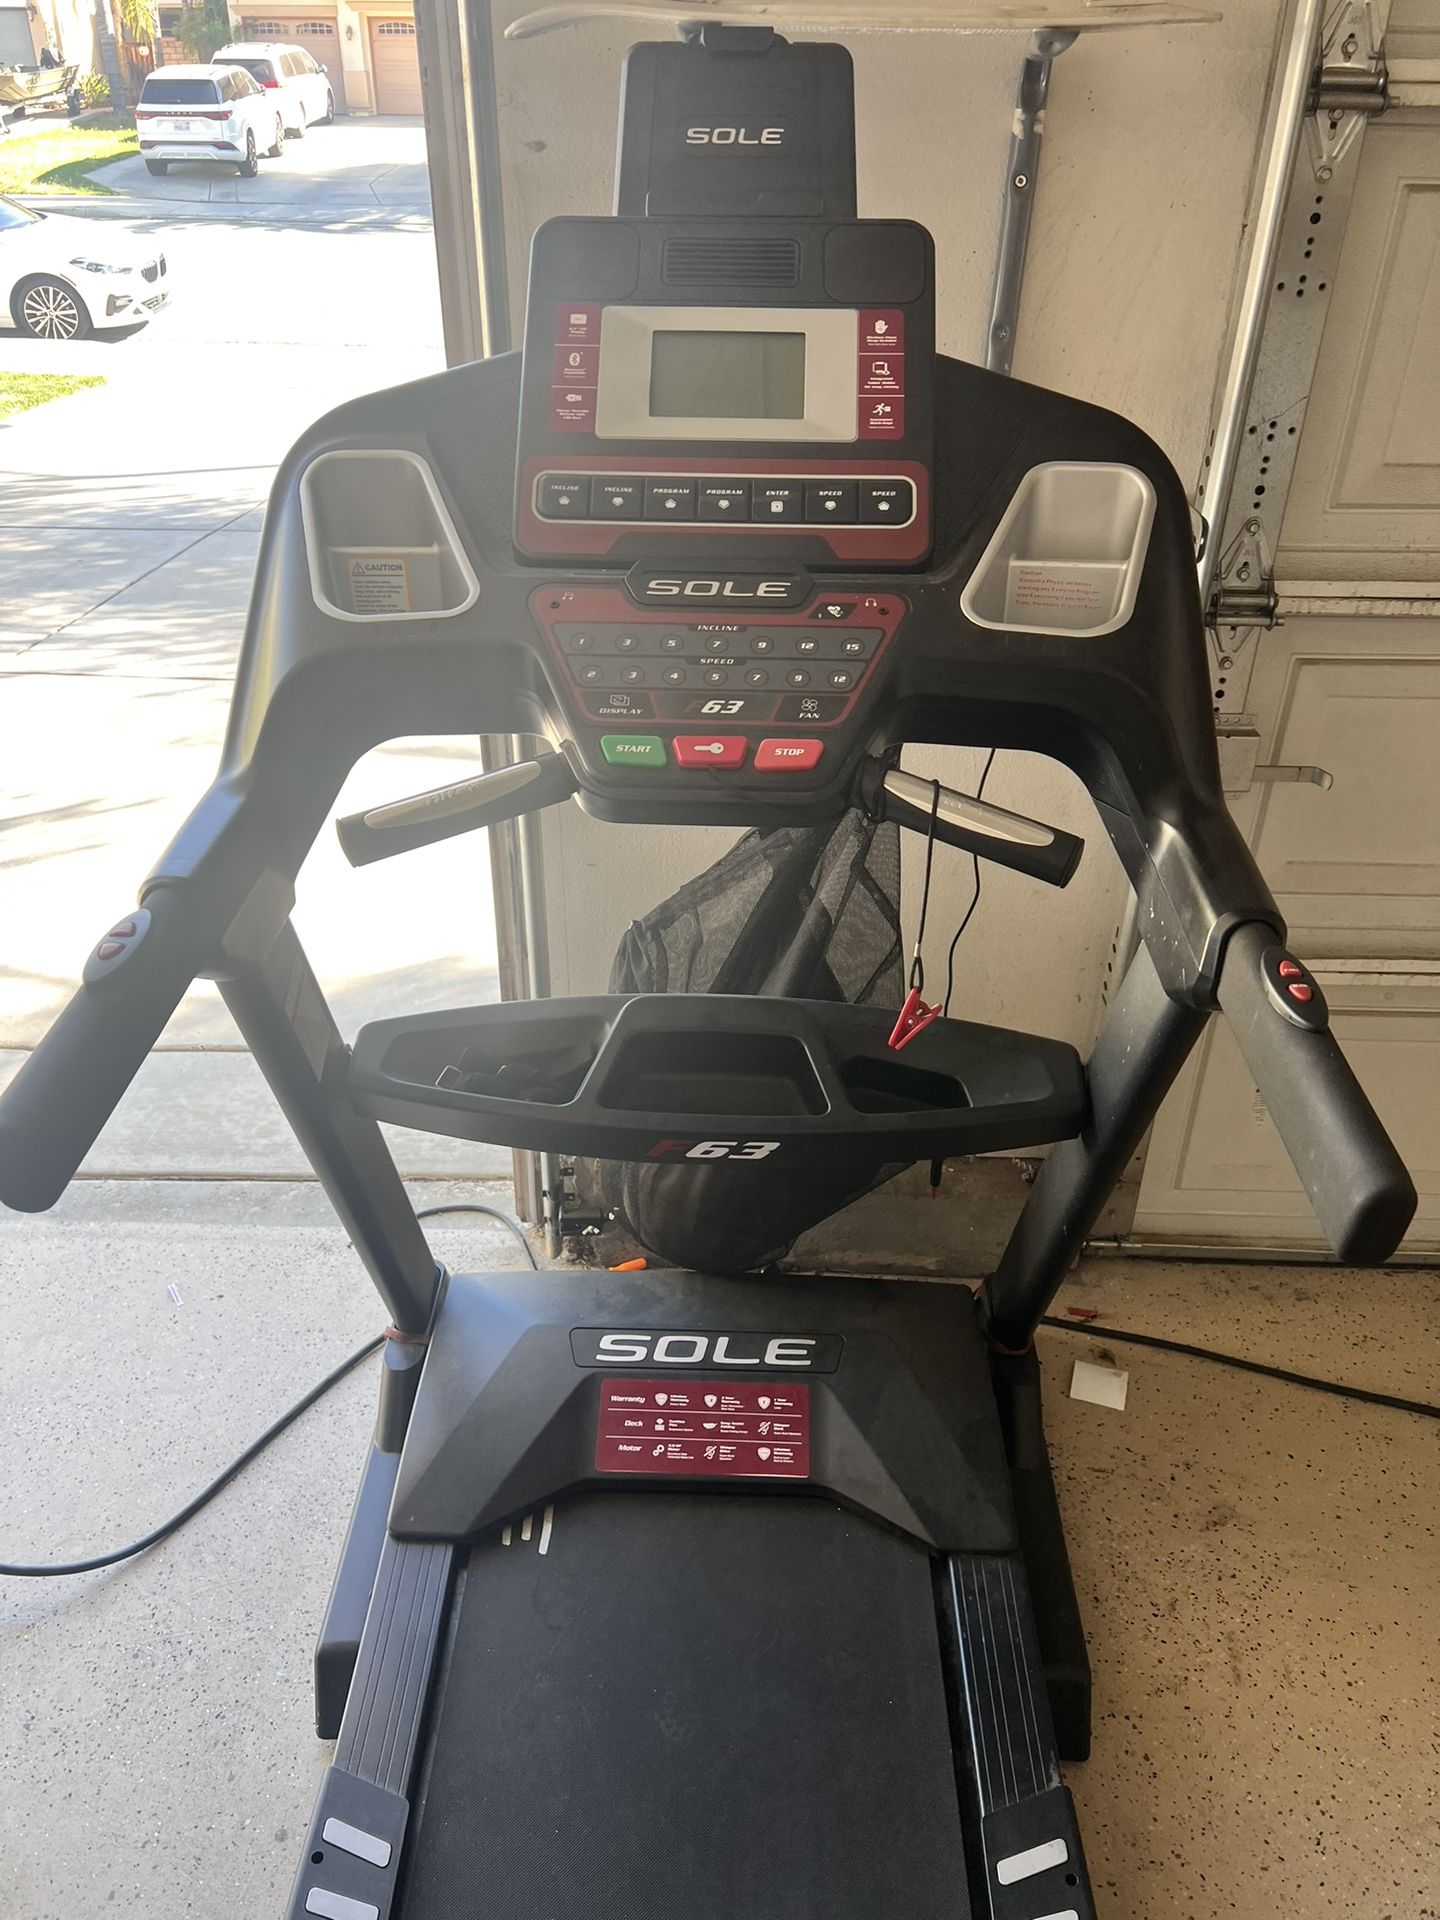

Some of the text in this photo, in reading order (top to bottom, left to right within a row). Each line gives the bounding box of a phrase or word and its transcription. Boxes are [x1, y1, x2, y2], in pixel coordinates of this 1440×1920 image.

[686, 128, 784, 145] SOLE
[365, 563, 403, 571] CAUTION
[646, 580, 791, 597] SOLE
[622, 638, 632, 646] 3
[667, 639, 677, 647] 5
[712, 640, 721, 648] 7
[758, 641, 767, 649] 9
[845, 643, 860, 651] 15
[587, 670, 596, 678] 2
[627, 671, 637, 679] 3
[670, 672, 679, 680] 4
[711, 673, 721, 681] 5
[752, 674, 761, 682] 7
[833, 675, 847, 683] 12
[599, 707, 643, 715] DISPLAY
[615, 744, 652, 753] START
[774, 748, 805, 756] STOP
[645, 1139, 782, 1160] F63
[596, 1335, 816, 1366] SOLE
[610, 1395, 646, 1404] Warranty
[618, 1444, 643, 1452] Motor
